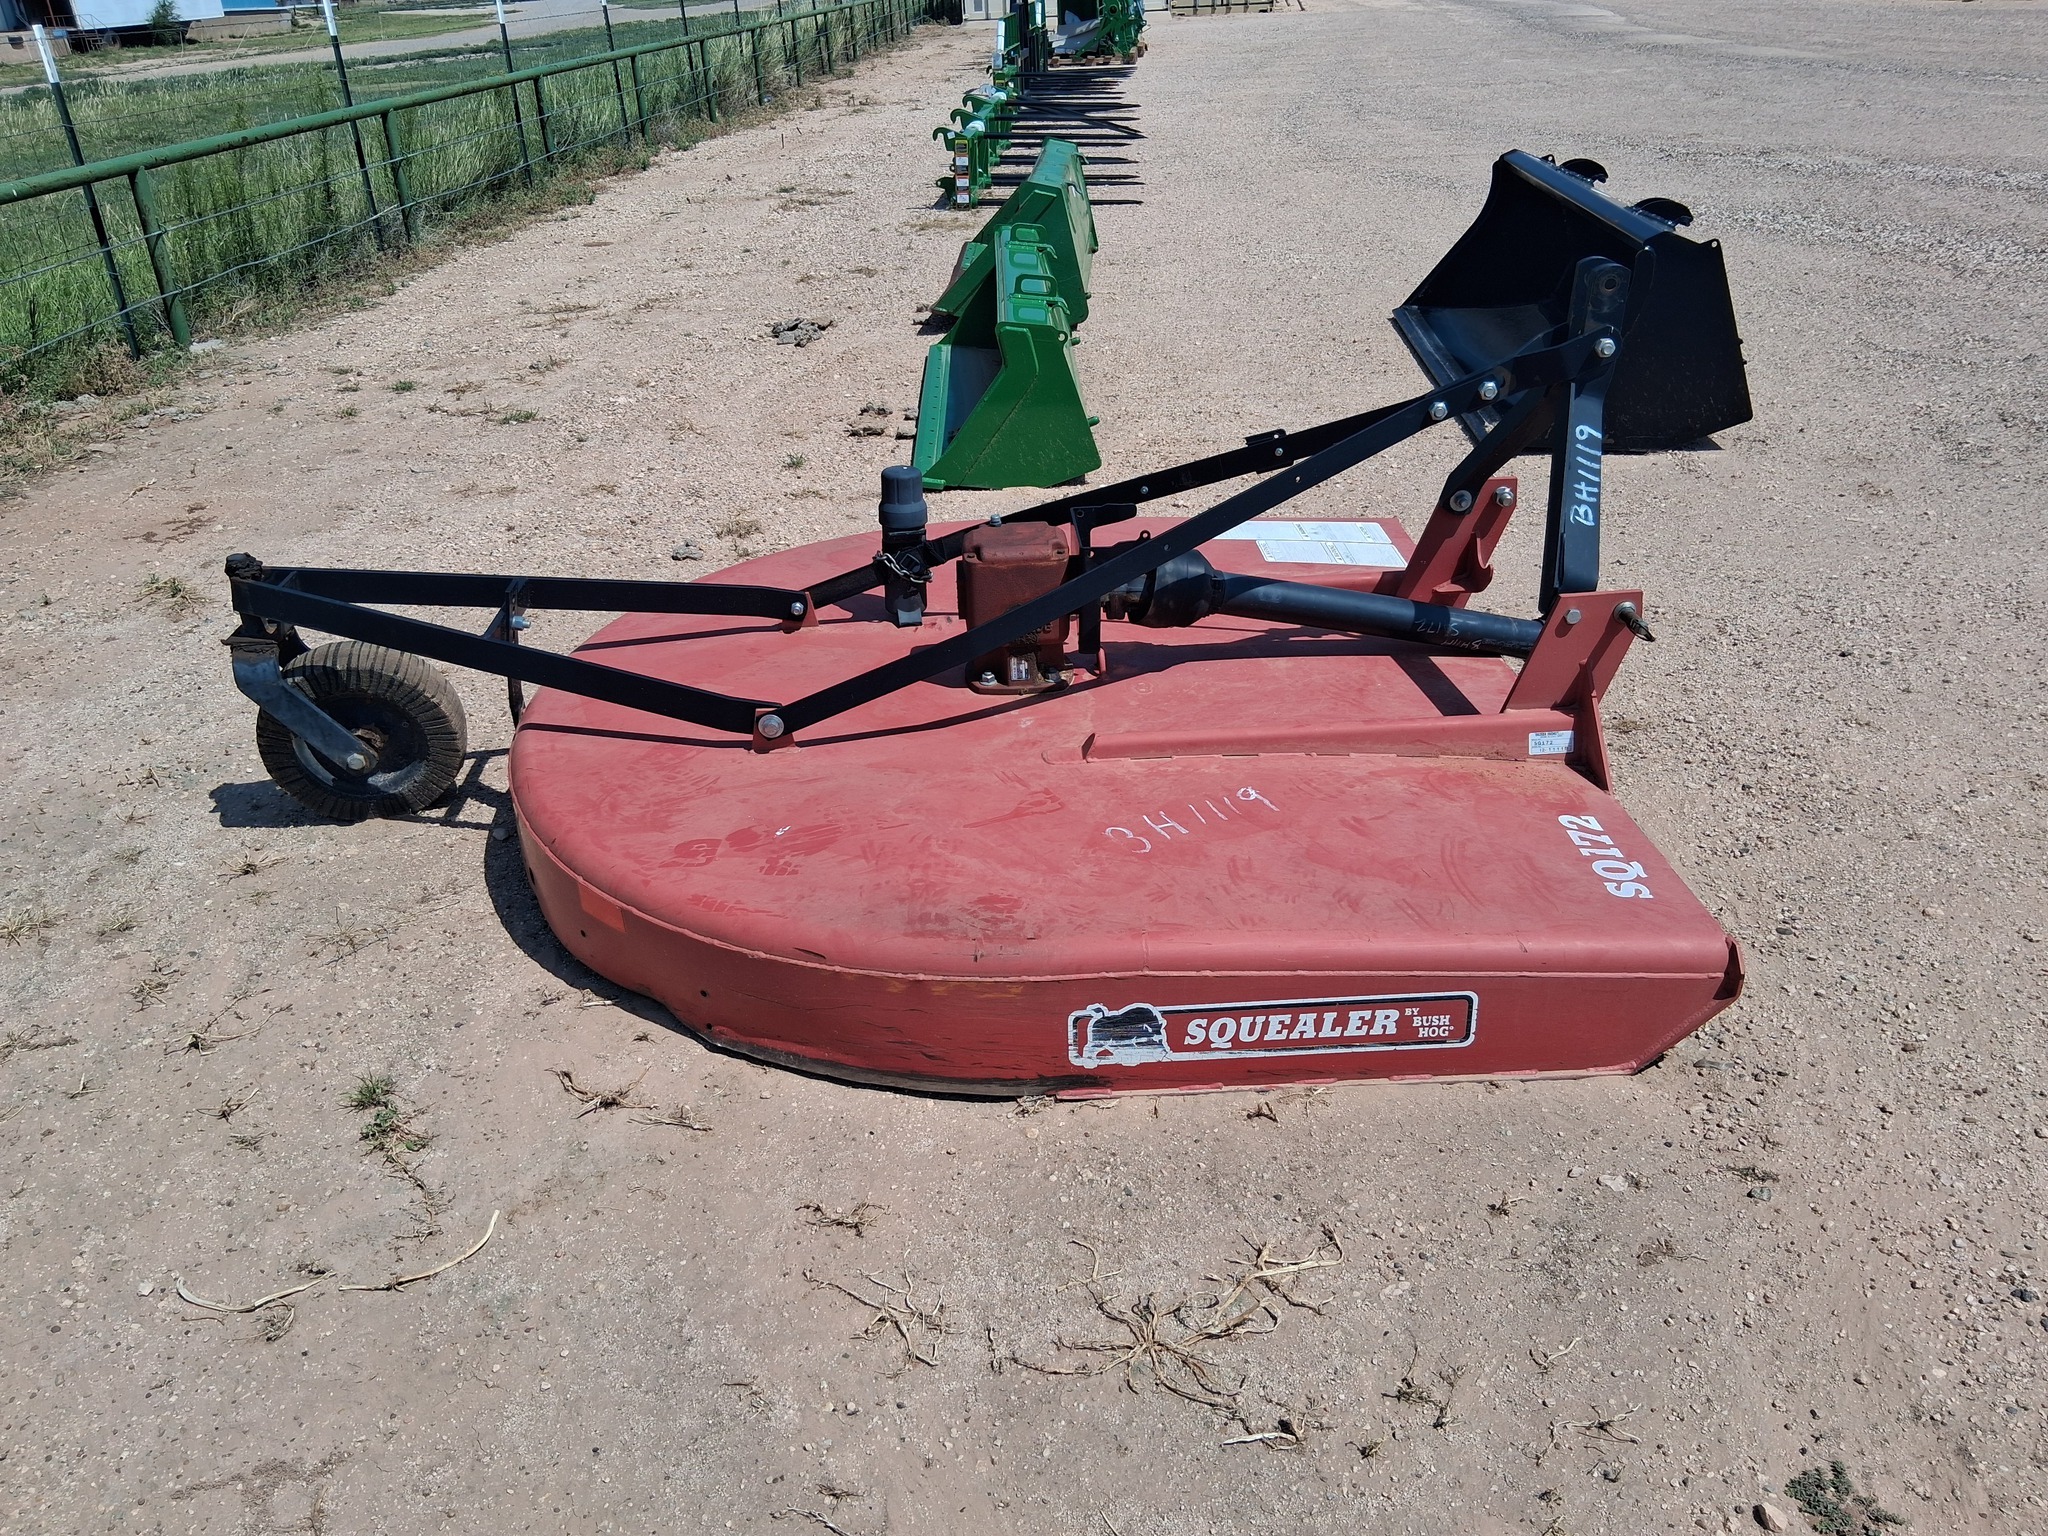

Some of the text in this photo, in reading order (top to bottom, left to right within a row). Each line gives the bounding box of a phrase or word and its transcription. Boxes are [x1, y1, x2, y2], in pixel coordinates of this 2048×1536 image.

[1570, 424, 1603, 526] BH1119
[1557, 815, 1654, 899] SQ172
[1183, 1008, 1400, 1048] SQUEALER
[1412, 1015, 1450, 1026] BUSH
